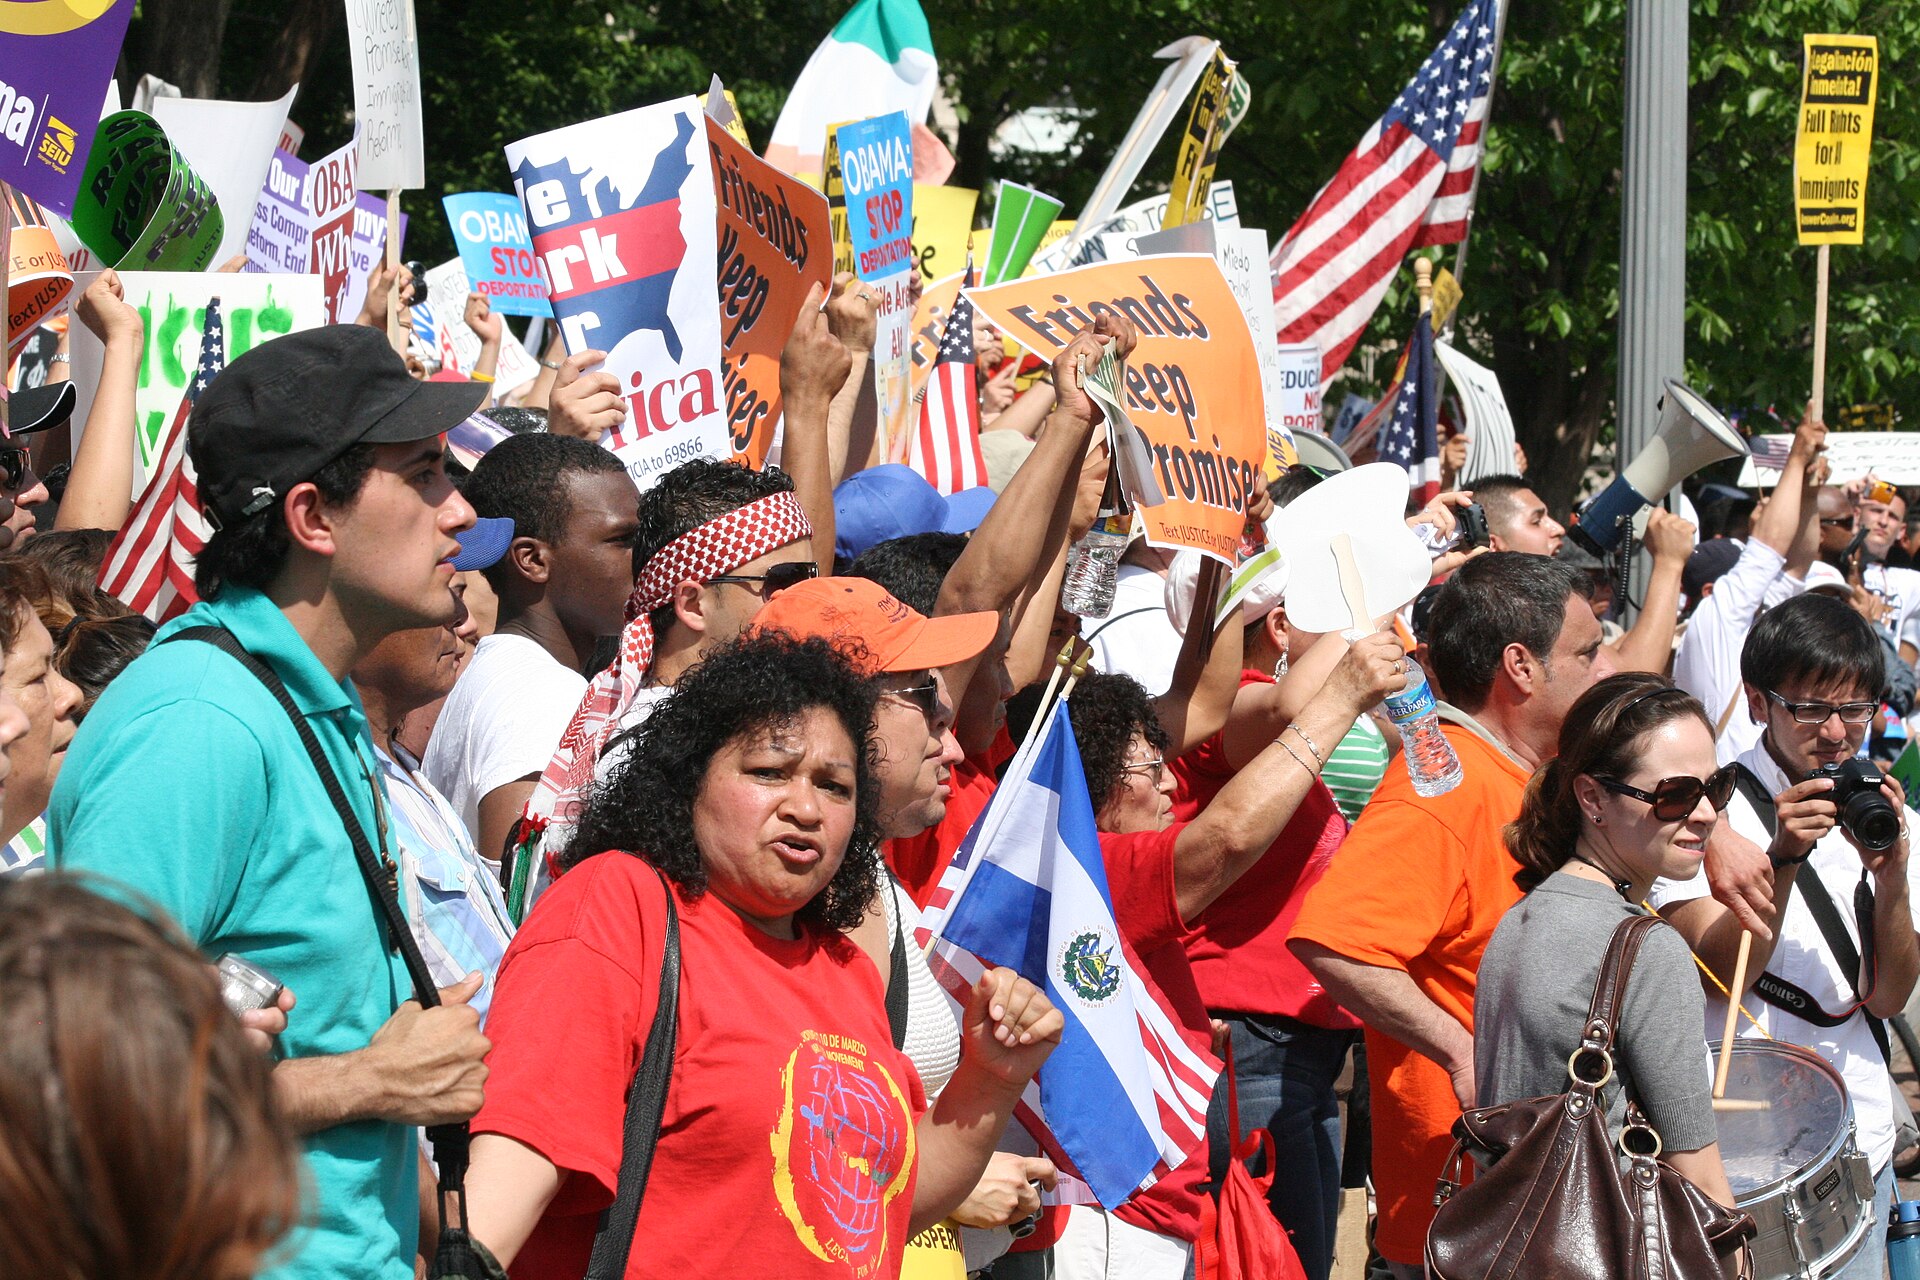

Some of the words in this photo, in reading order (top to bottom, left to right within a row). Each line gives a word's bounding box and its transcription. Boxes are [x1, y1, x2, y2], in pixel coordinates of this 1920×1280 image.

[1804, 109, 1827, 134] Full
[39, 139, 72, 167] SEIU
[844, 136, 912, 196] OBAMA:
[1815, 141, 1833, 165] for
[270, 157, 300, 202] Our
[709, 139, 809, 273] Friends
[866, 189, 904, 241] STOP
[29, 255, 45, 269] or
[284, 248, 306, 274] End
[1223, 244, 1250, 273] Miedo
[891, 327, 903, 361] All
[1126, 361, 1198, 441] eep
[650, 455, 664, 471] to
[664, 435, 704, 467] 69866
[1134, 432, 1259, 518] romise
[1159, 522, 1180, 540] Text
[1180, 525, 1211, 546] JUSTICE
[1407, 694, 1428, 713] PARK
[1759, 978, 1806, 1009] Canon
[829, 1034, 840, 1049] DE
[841, 1035, 867, 1057] MARZO
[857, 1266, 869, 1279] FOR
